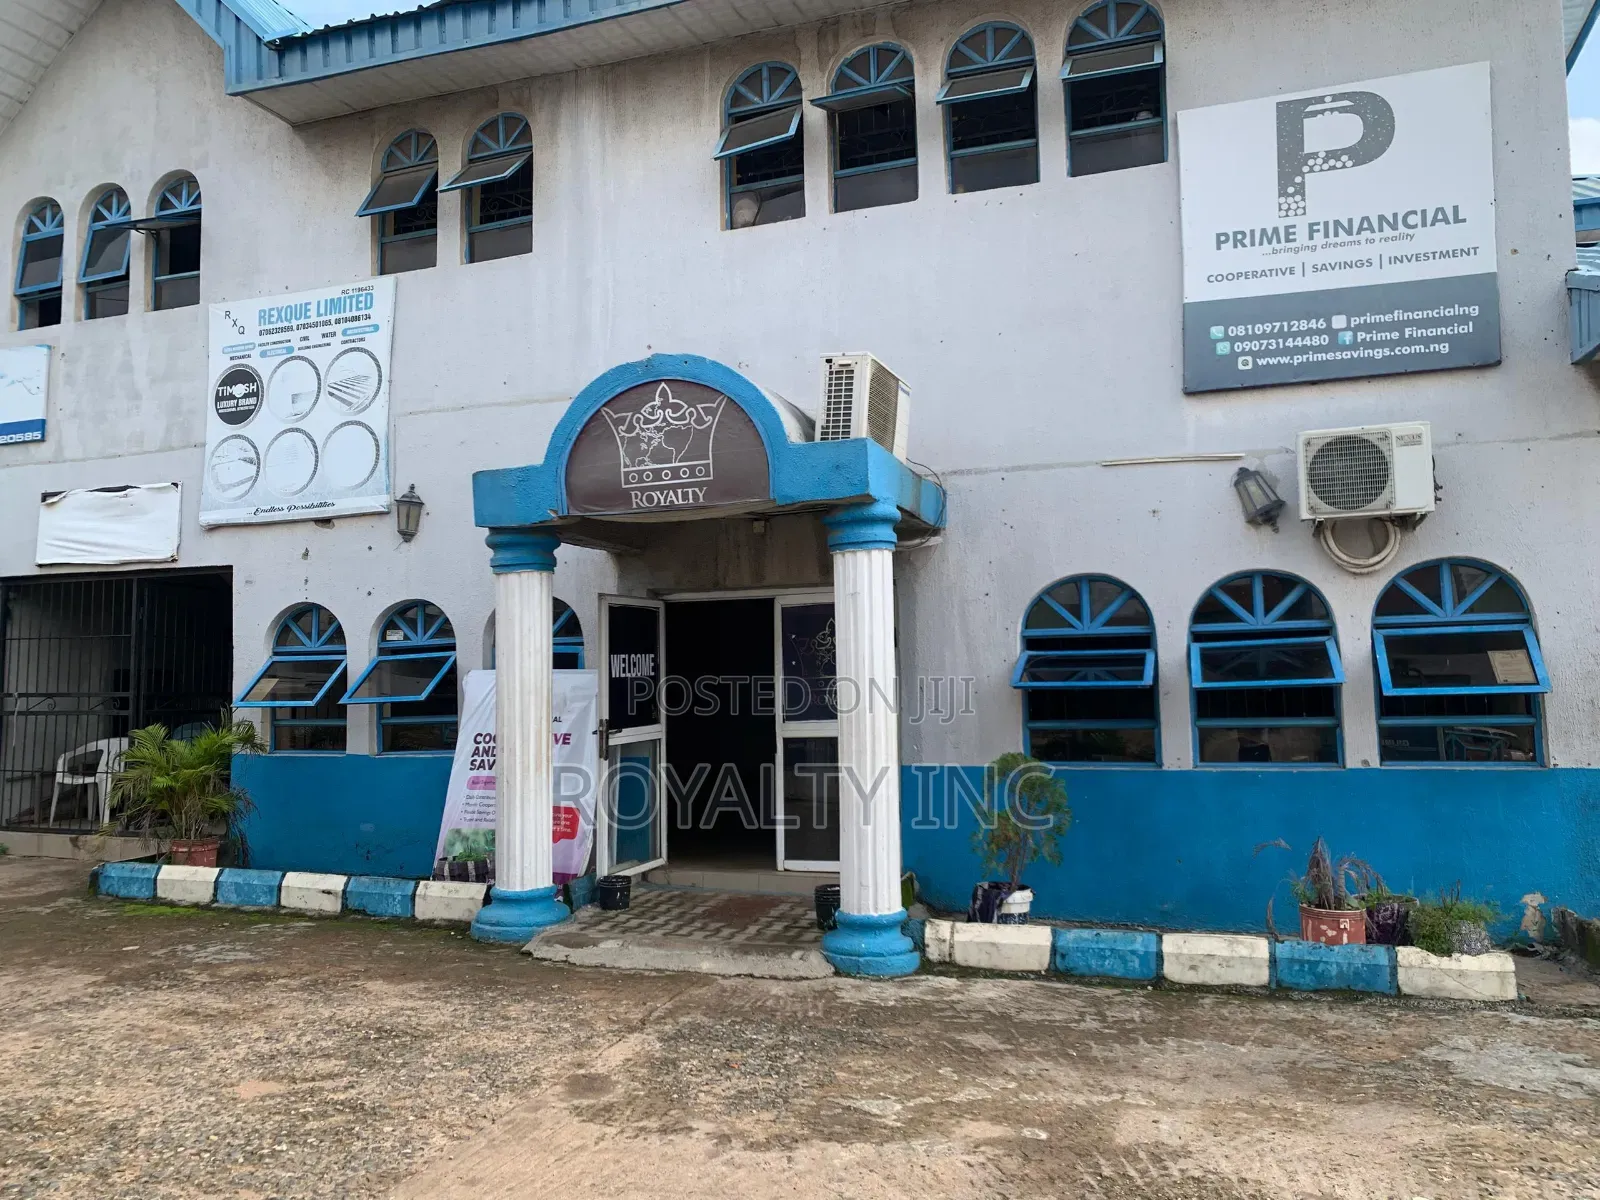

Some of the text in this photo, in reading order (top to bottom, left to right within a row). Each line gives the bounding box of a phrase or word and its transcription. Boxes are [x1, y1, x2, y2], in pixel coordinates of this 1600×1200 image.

[1215, 205, 1467, 250] PRIME FINANCIAL
[1321, 238, 1361, 249] dreams
[1365, 235, 1376, 245] to
[1379, 231, 1415, 245] reality
[1206, 246, 1480, 284] COOPERATIVE SAVINGS INVESTMENT
[224, 311, 231, 320] R
[258, 291, 374, 326] REXQUE LIMITED
[1350, 304, 1479, 328] primefinancialng
[232, 319, 238, 327] X
[237, 326, 245, 335] Q
[1228, 318, 1327, 337] 08109712846
[1357, 329, 1400, 343] Prime
[1404, 321, 1474, 340] Financial
[321, 331, 337, 339] WATER
[1234, 335, 1330, 353] 09073144480
[1256, 340, 1450, 367] www.primesavings.com.ng
[216, 399, 238, 409] LUXURY
[238, 396, 257, 406] BRAND
[629, 486, 708, 509] ROYALTY
[610, 653, 655, 678] WELCOME
